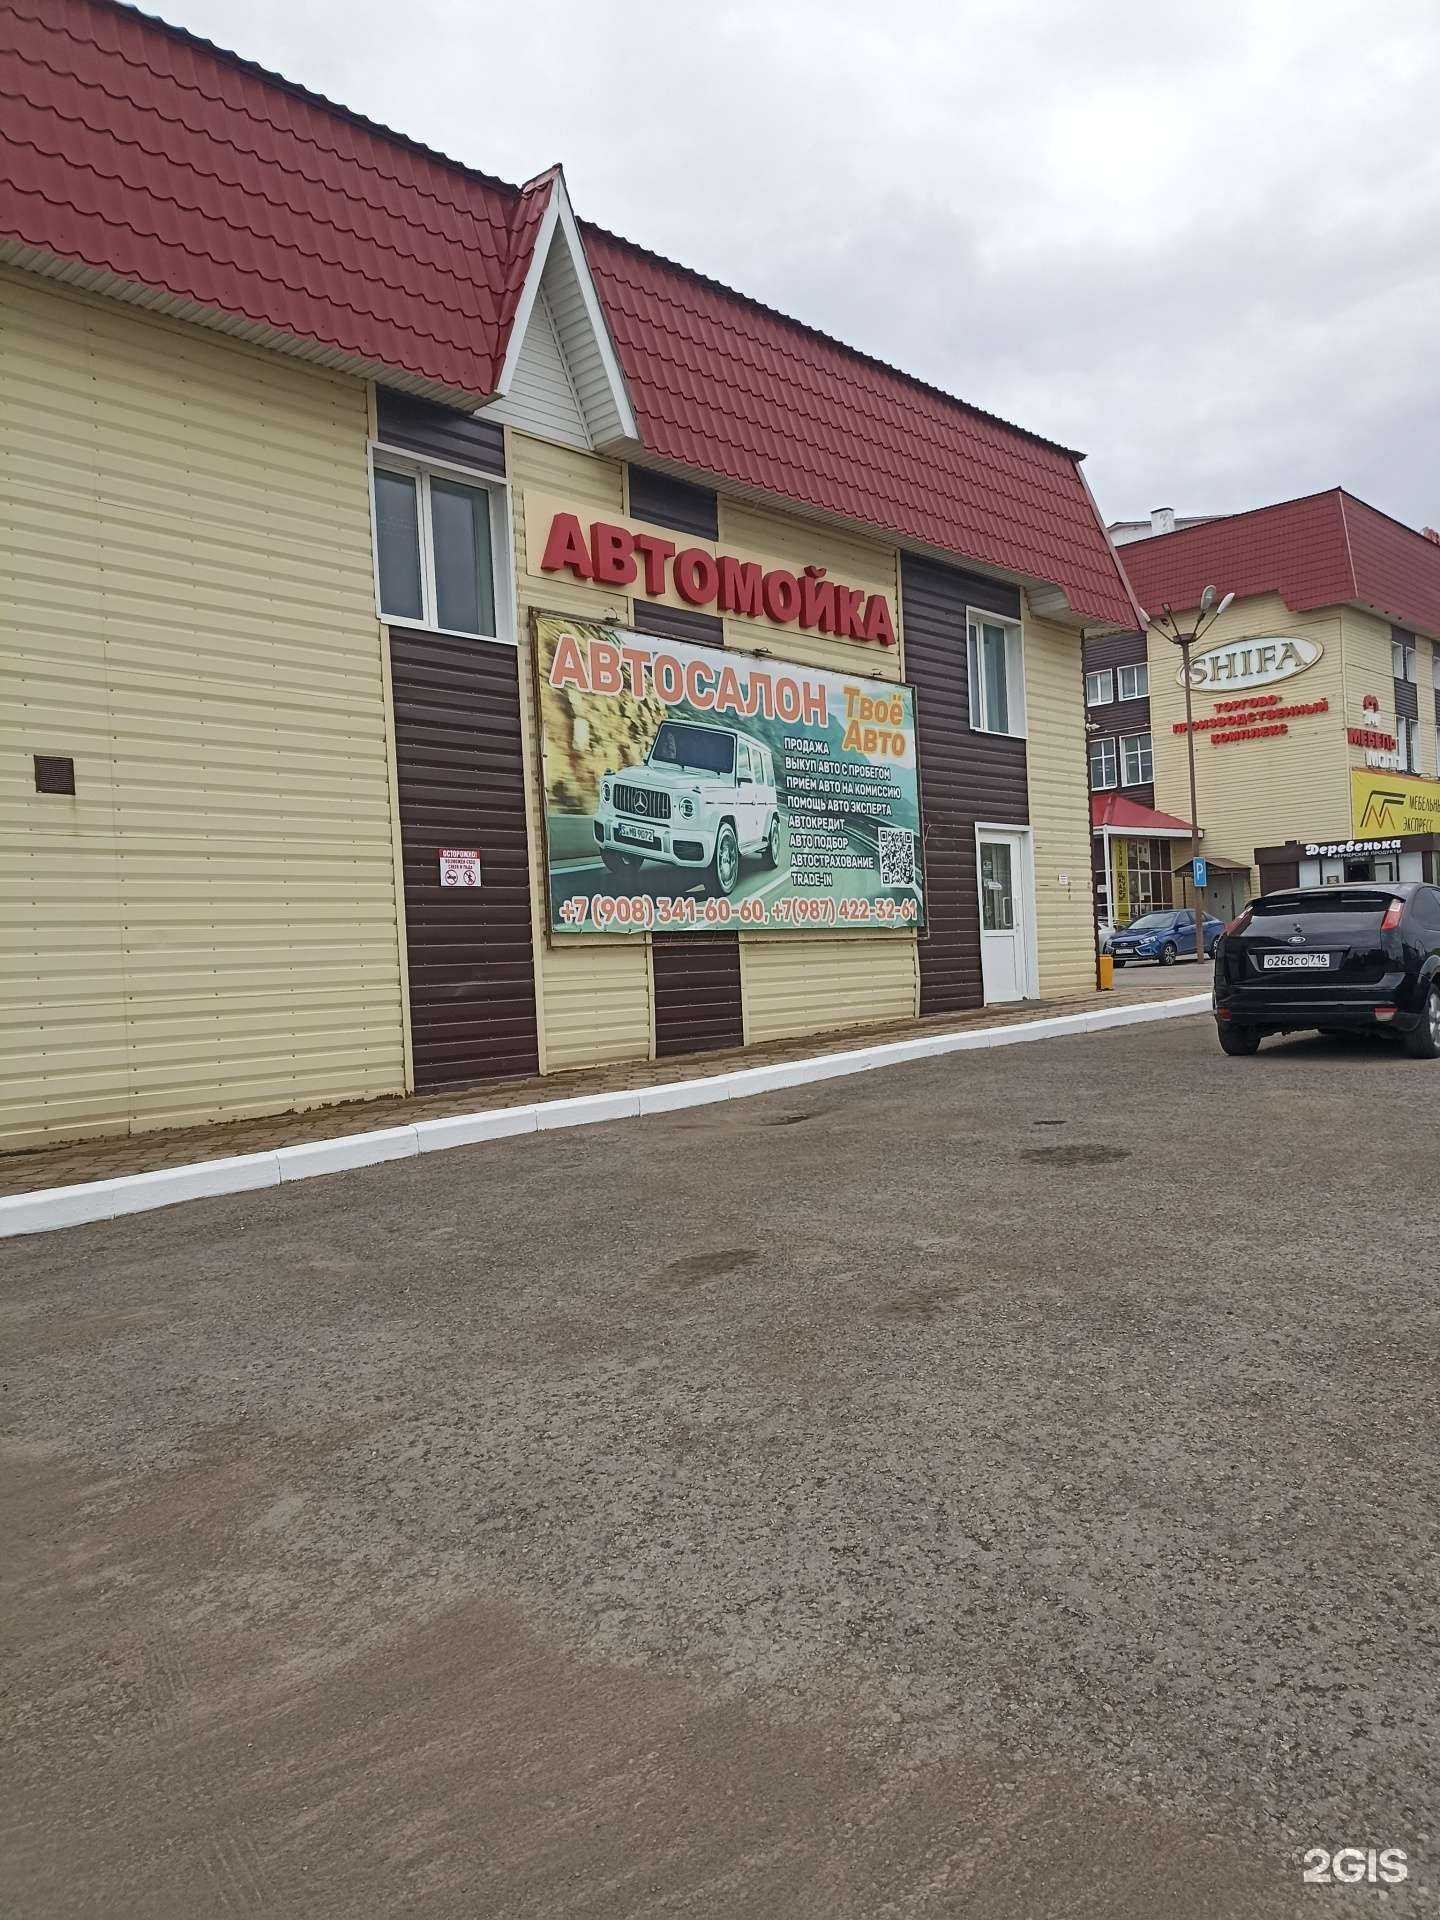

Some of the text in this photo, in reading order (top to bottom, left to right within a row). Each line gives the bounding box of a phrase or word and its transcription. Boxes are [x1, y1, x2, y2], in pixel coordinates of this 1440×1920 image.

[541, 512, 895, 646] АВТОМОЙКА
[1188, 642, 1307, 684] SHIFA
[550, 635, 828, 728] АВТОСАЛОН
[1214, 695, 1283, 713] ТОРГОВО-
[1211, 724, 1288, 744] КОМПЛЕКС
[1347, 728, 1396, 751] МЕБЕЛЬ
[784, 737, 830, 755] ПРОДАЖА
[785, 757, 891, 780] ВЫКУП АВТО С ПРОБЕГОМ
[819, 779, 840, 793] АВТО
[842, 783, 854, 795] НА
[855, 784, 901, 799] КОМИССИЮ
[787, 796, 892, 816] ПОМОЩЬ АВТО ЭКСПЕРТА
[1409, 795, 1440, 812] МЕБЕЛЬН
[788, 815, 845, 831] АВТОКРЕДИТ
[790, 834, 849, 851] АВТО ПОДБОР
[790, 853, 874, 869] АВТОСТРАХОВАНИЕ
[1196, 862, 1204, 880] P
[791, 871, 833, 887] TRADE-IN
[559, 896, 589, 925] +7
[591, 894, 655, 929] (908)
[838, 898, 918, 922] 422-32-61
